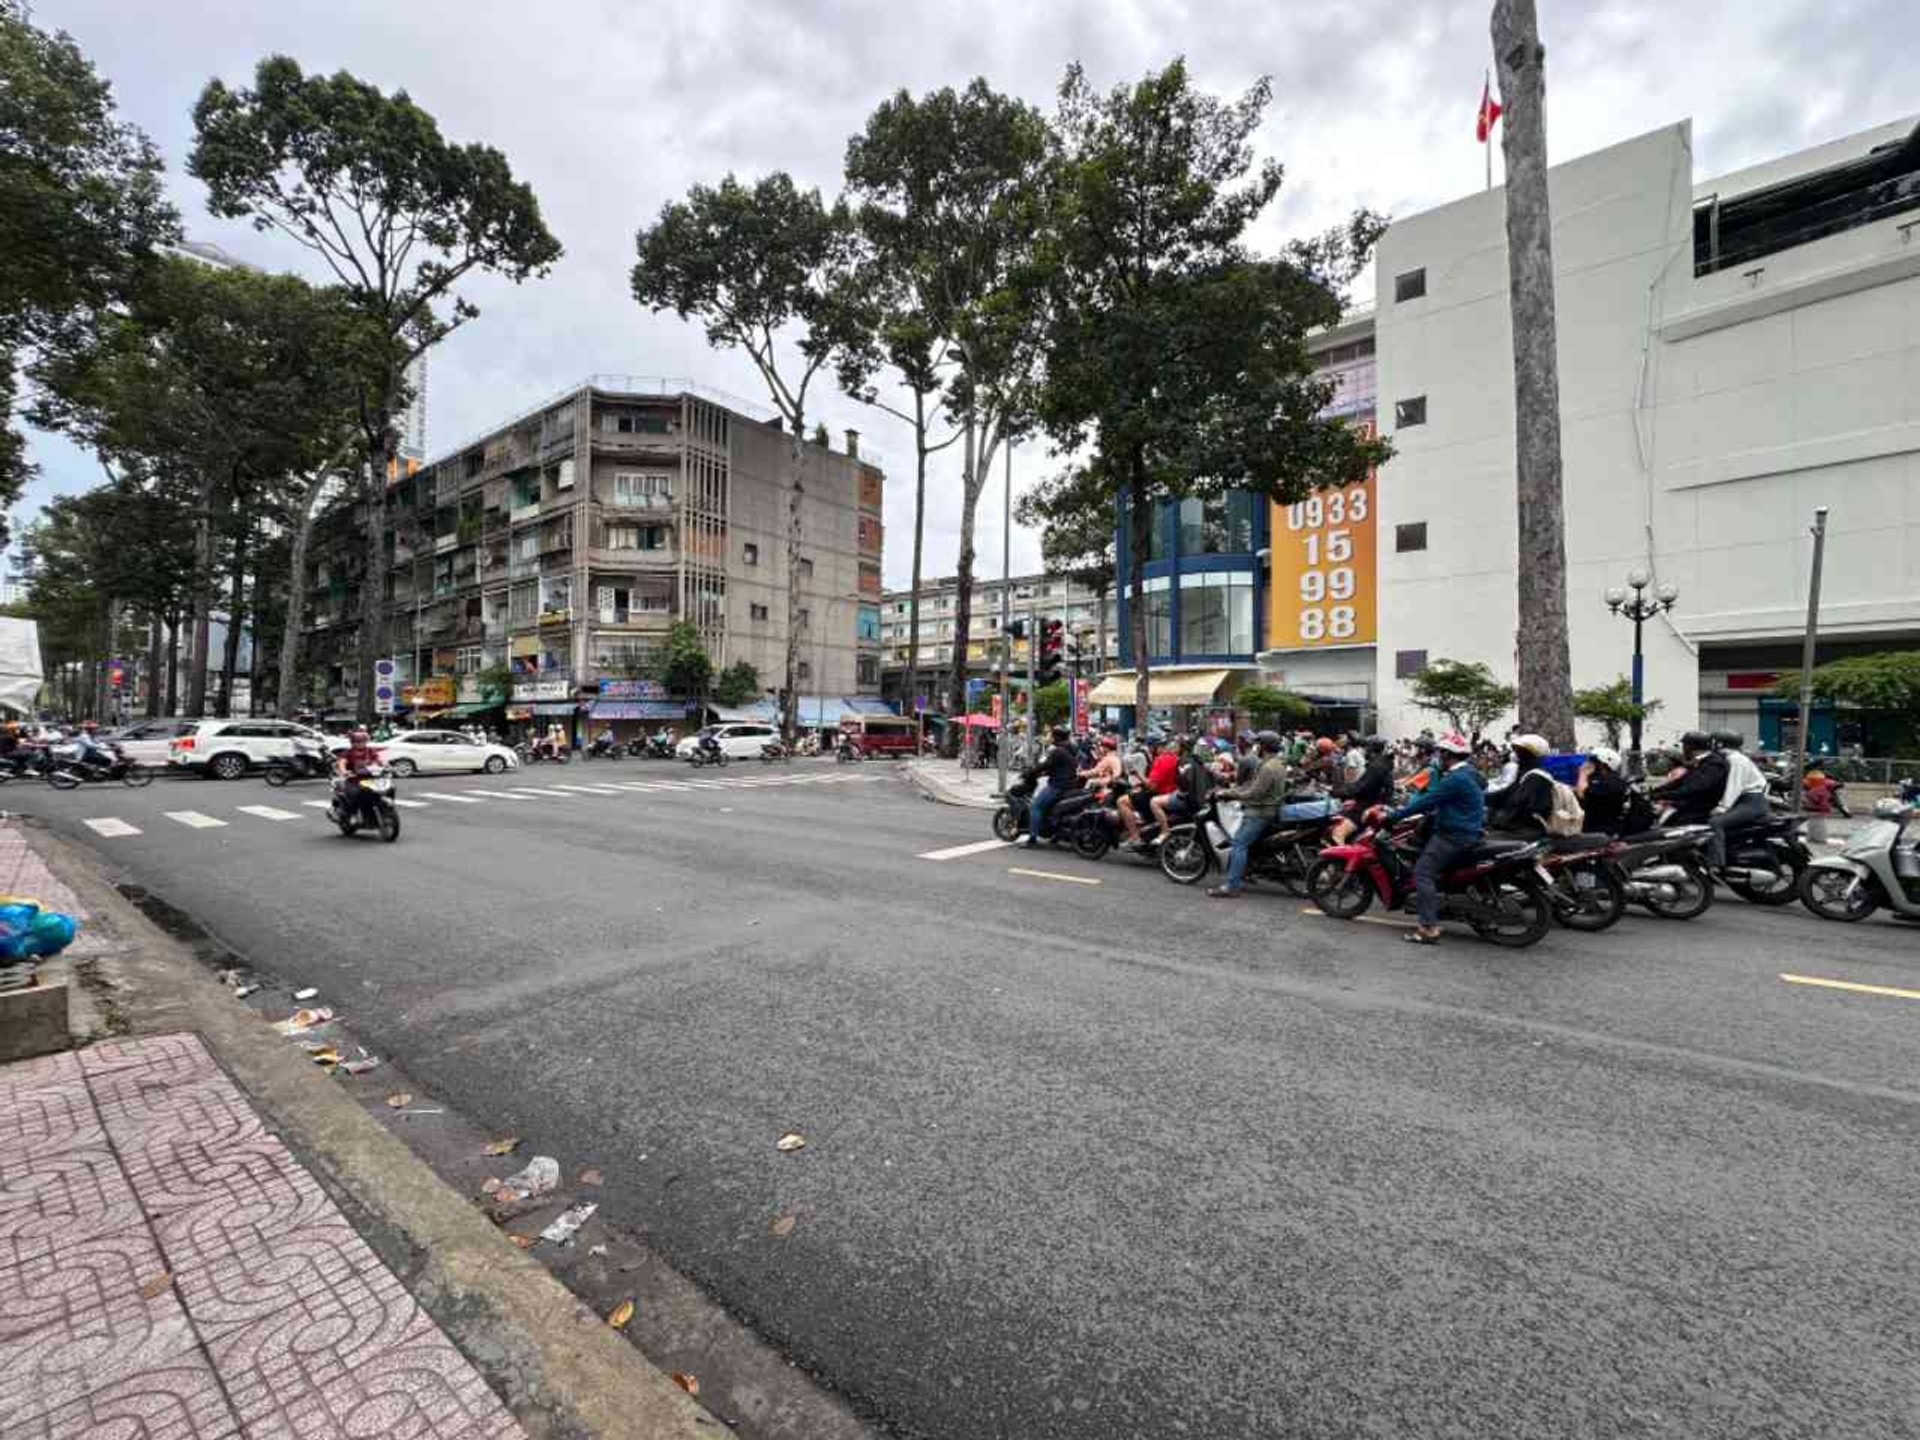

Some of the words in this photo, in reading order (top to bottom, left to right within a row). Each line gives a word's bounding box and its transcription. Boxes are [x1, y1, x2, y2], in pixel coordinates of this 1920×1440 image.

[1287, 487, 1368, 530] 0933
[1303, 529, 1353, 566] 15
[1300, 567, 1355, 603] 99
[1300, 605, 1356, 641] 88
